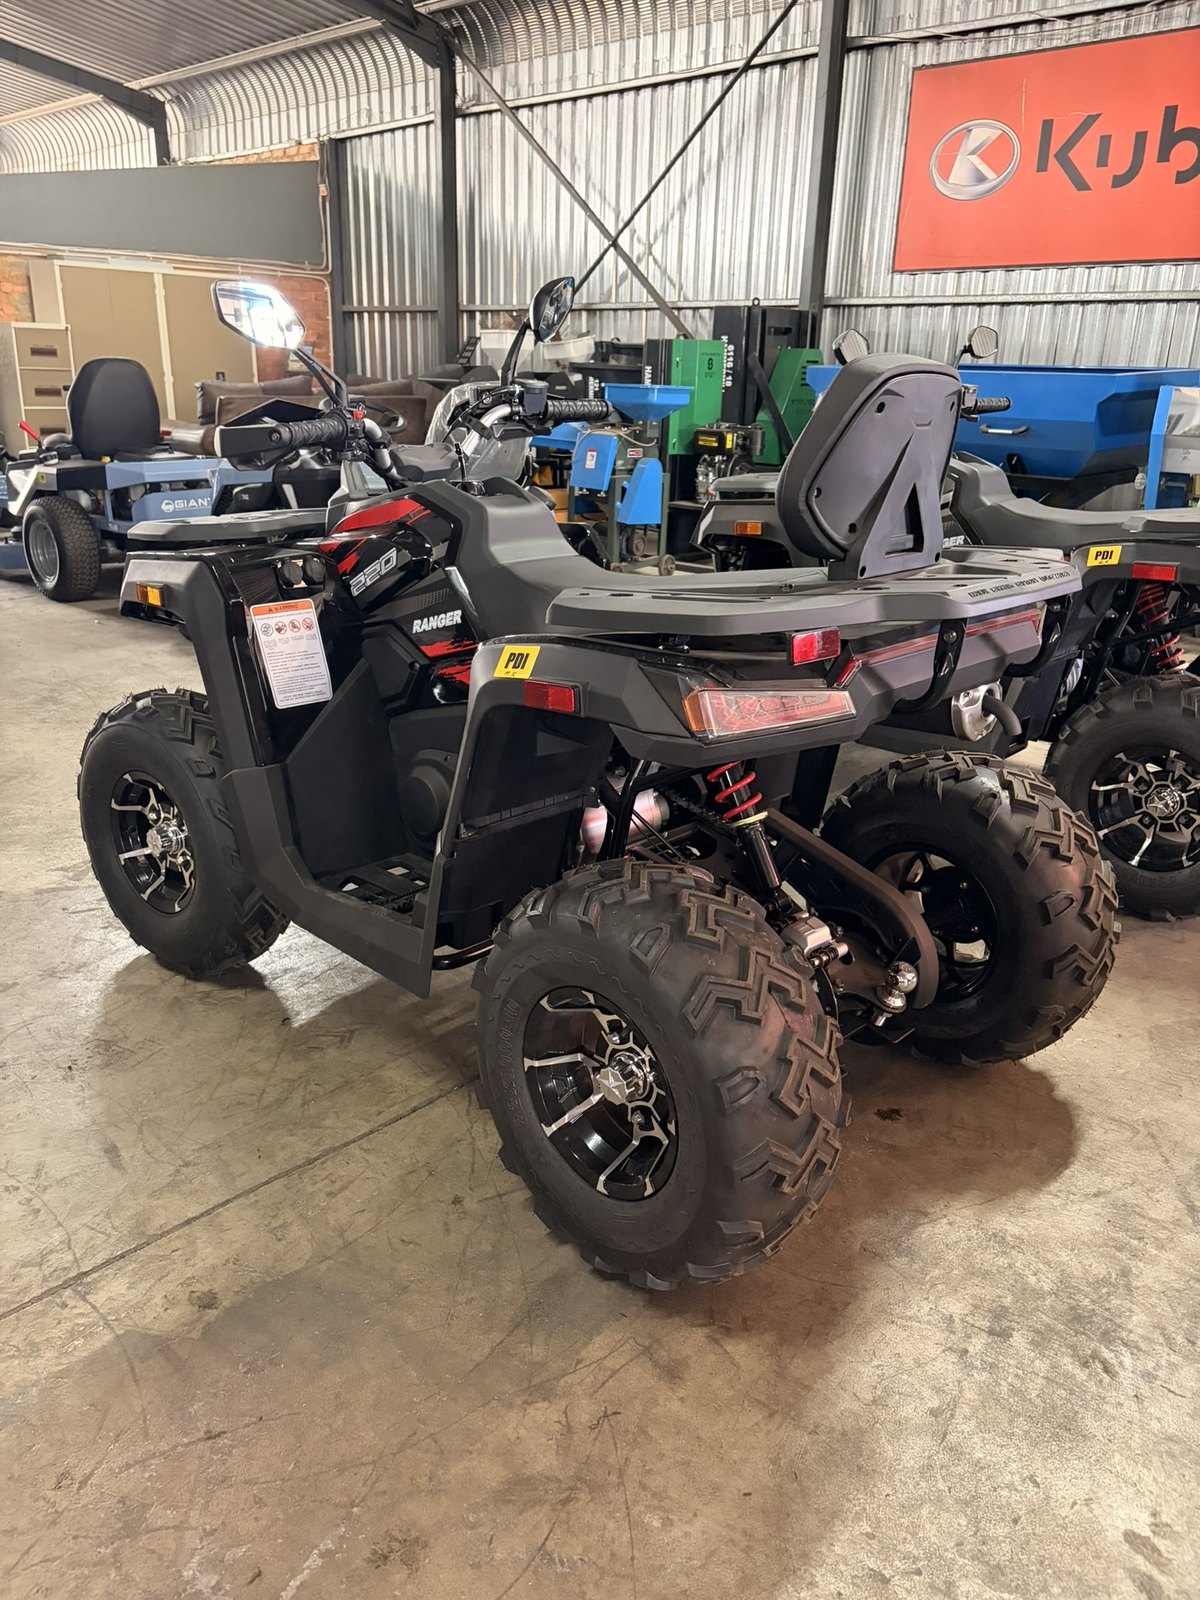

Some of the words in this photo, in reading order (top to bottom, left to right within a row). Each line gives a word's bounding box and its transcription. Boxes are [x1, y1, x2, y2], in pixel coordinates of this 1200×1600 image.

[175, 497, 211, 508] GIAN
[1094, 550, 1114, 560] PDI
[349, 547, 398, 597] 220
[412, 610, 462, 634] RANGER
[504, 652, 530, 669] PDI
